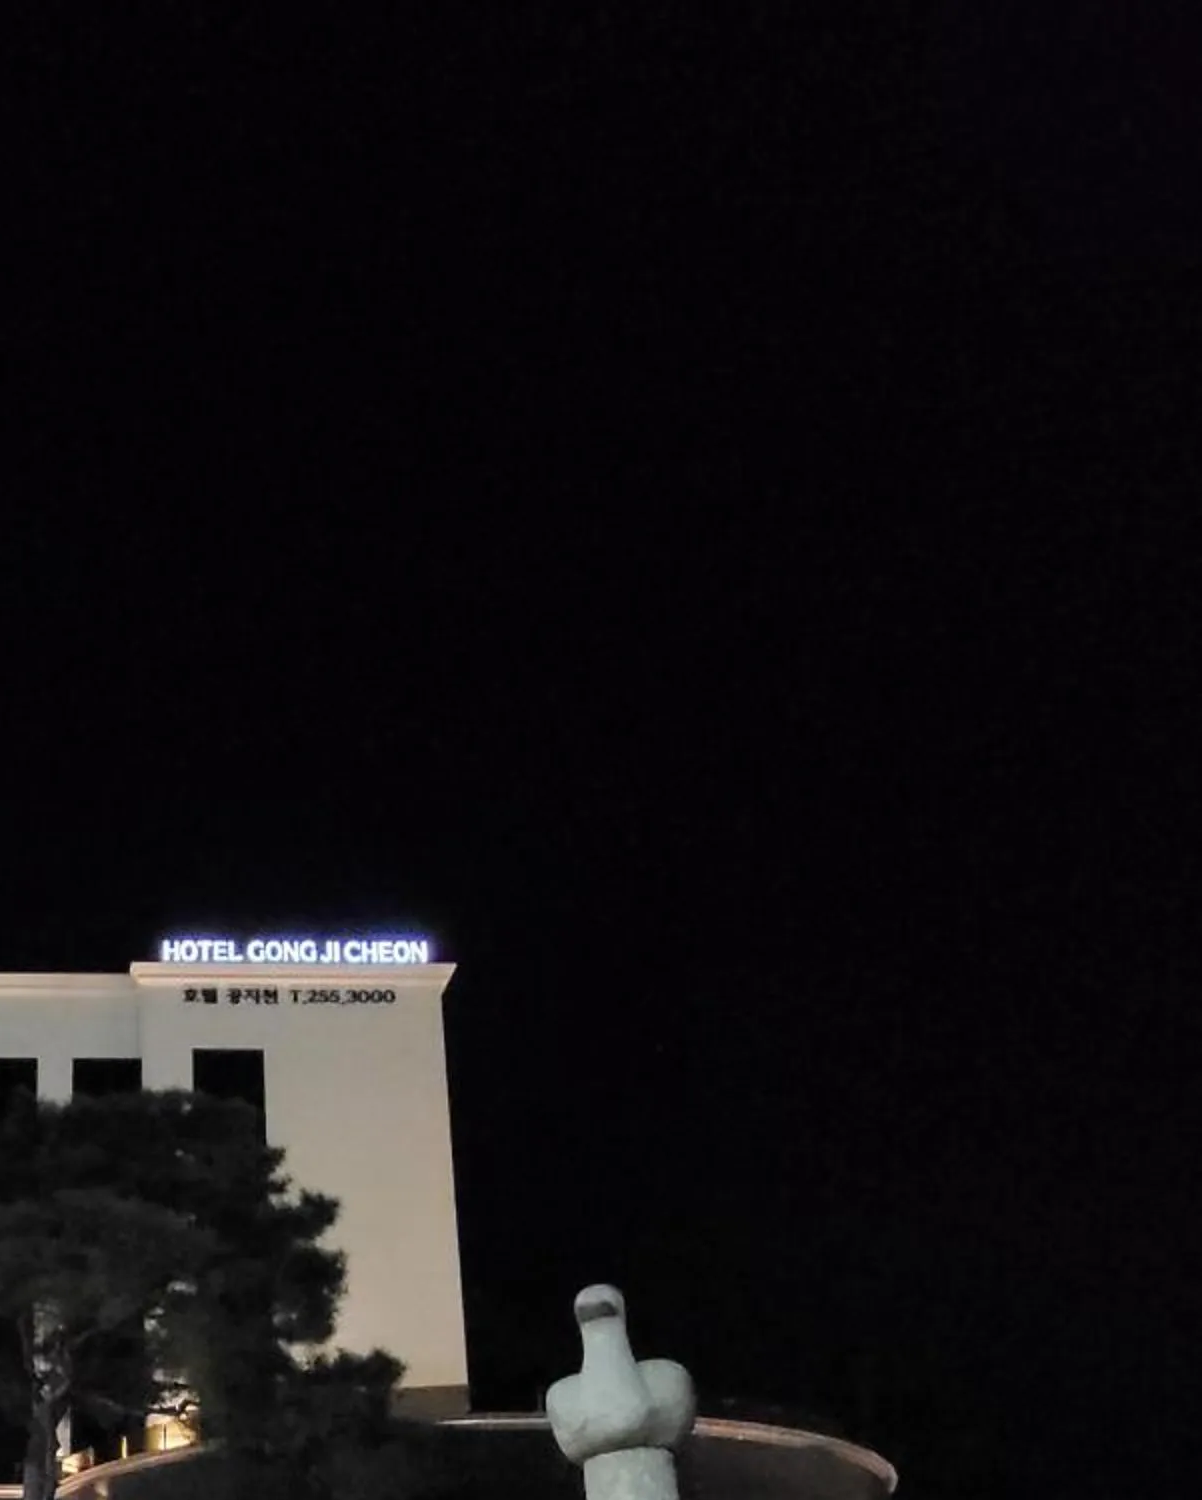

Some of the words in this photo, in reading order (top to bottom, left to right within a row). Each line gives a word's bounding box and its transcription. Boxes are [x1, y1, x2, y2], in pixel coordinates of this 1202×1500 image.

[161, 939, 244, 963] HOTEL
[246, 939, 317, 963] GONG
[183, 988, 219, 1005] 호텔
[225, 987, 279, 1005] 공지천
